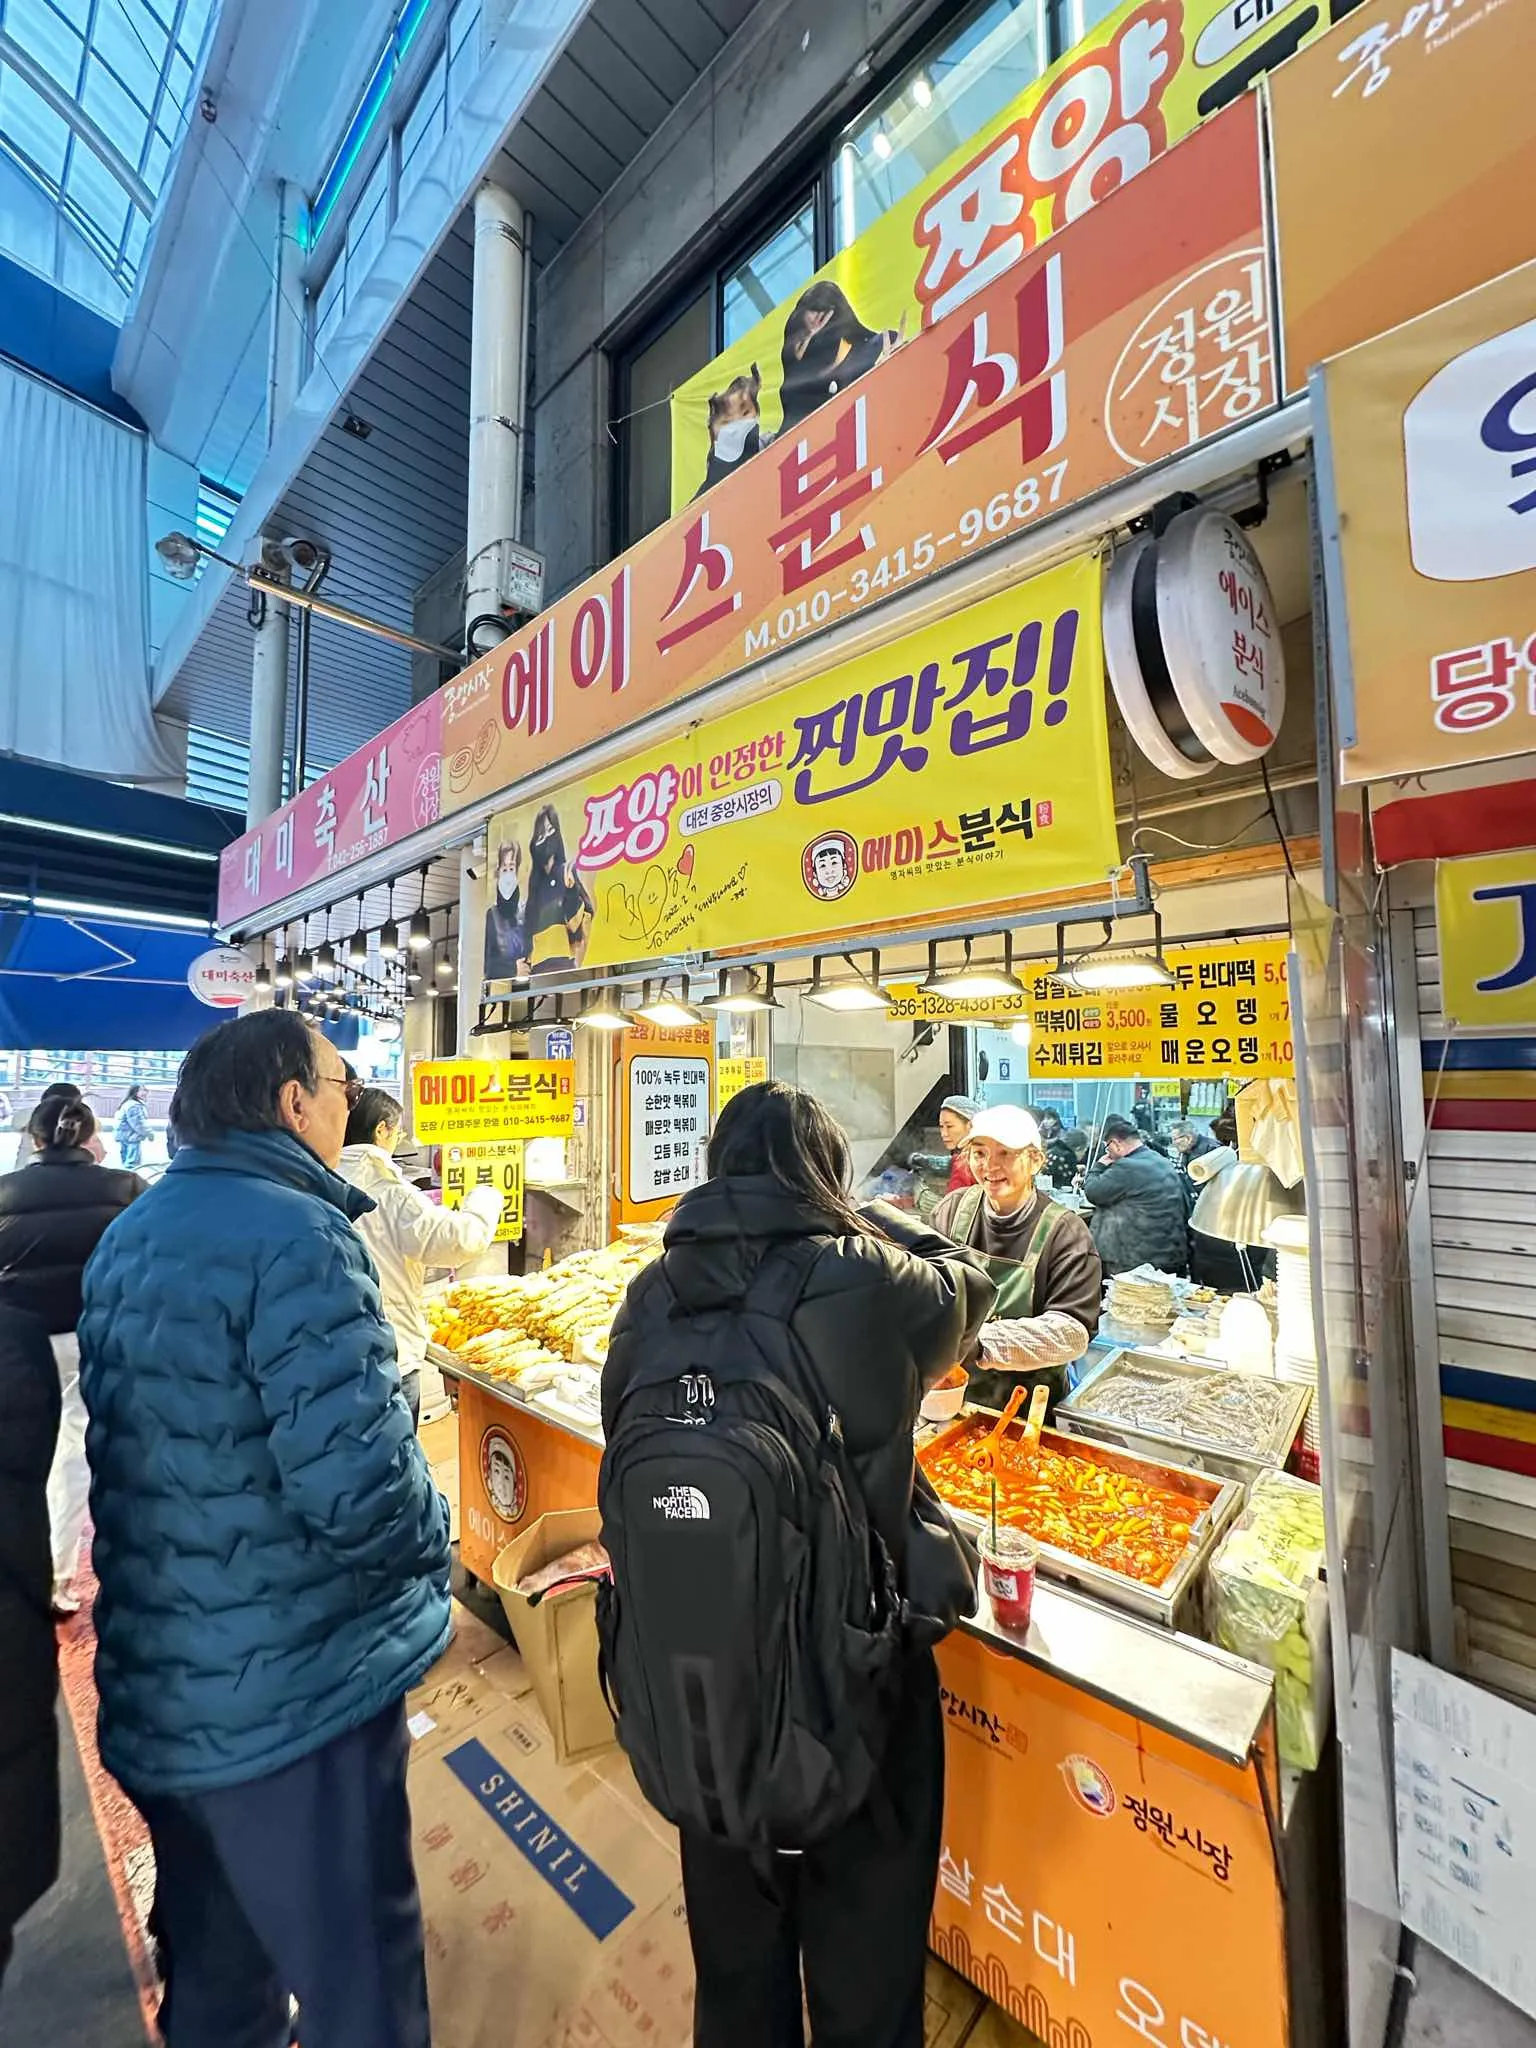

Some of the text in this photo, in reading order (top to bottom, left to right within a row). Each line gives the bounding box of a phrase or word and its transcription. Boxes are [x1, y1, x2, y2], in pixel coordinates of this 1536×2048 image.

[1120, 261, 1263, 401] 정원
[1139, 344, 1271, 446] 시장
[502, 252, 1066, 738] 에이스분식
[743, 459, 1070, 659] M.010-3415-9687
[1218, 570, 1271, 639] 에이스
[1232, 629, 1264, 691] 분식
[787, 609, 1080, 804] 찐맛집!
[709, 733, 786, 790] 인정한
[243, 744, 392, 896] 대미축산
[686, 784, 773, 830] 대전 중앙시장의
[862, 798, 1035, 873] 에이스분식
[1034, 977, 1101, 1000] 찹쌀
[1199, 960, 1256, 989] 빈대떡
[1035, 1008, 1081, 1033] 떡볶이
[1035, 1042, 1102, 1067] 수제튀김
[419, 1073, 558, 1105] 에이스분식
[635, 1070, 706, 1085] 100% 녹두 빈대떡
[645, 1094, 697, 1111] 순한맛 떡볶이
[503, 1113, 570, 1127] 010-3415-9687
[645, 1118, 697, 1136] 매운맛 떡볶이
[654, 1142, 689, 1160] 모듬 튀김
[654, 1166, 690, 1185] 찹쌀 순대
[652, 1496, 691, 1509] NORTH
[668, 1486, 690, 1497] THE
[665, 1507, 692, 1519] FACE
[480, 1773, 588, 1893] SHINIL
[1122, 1794, 1233, 1881] 정원시장
